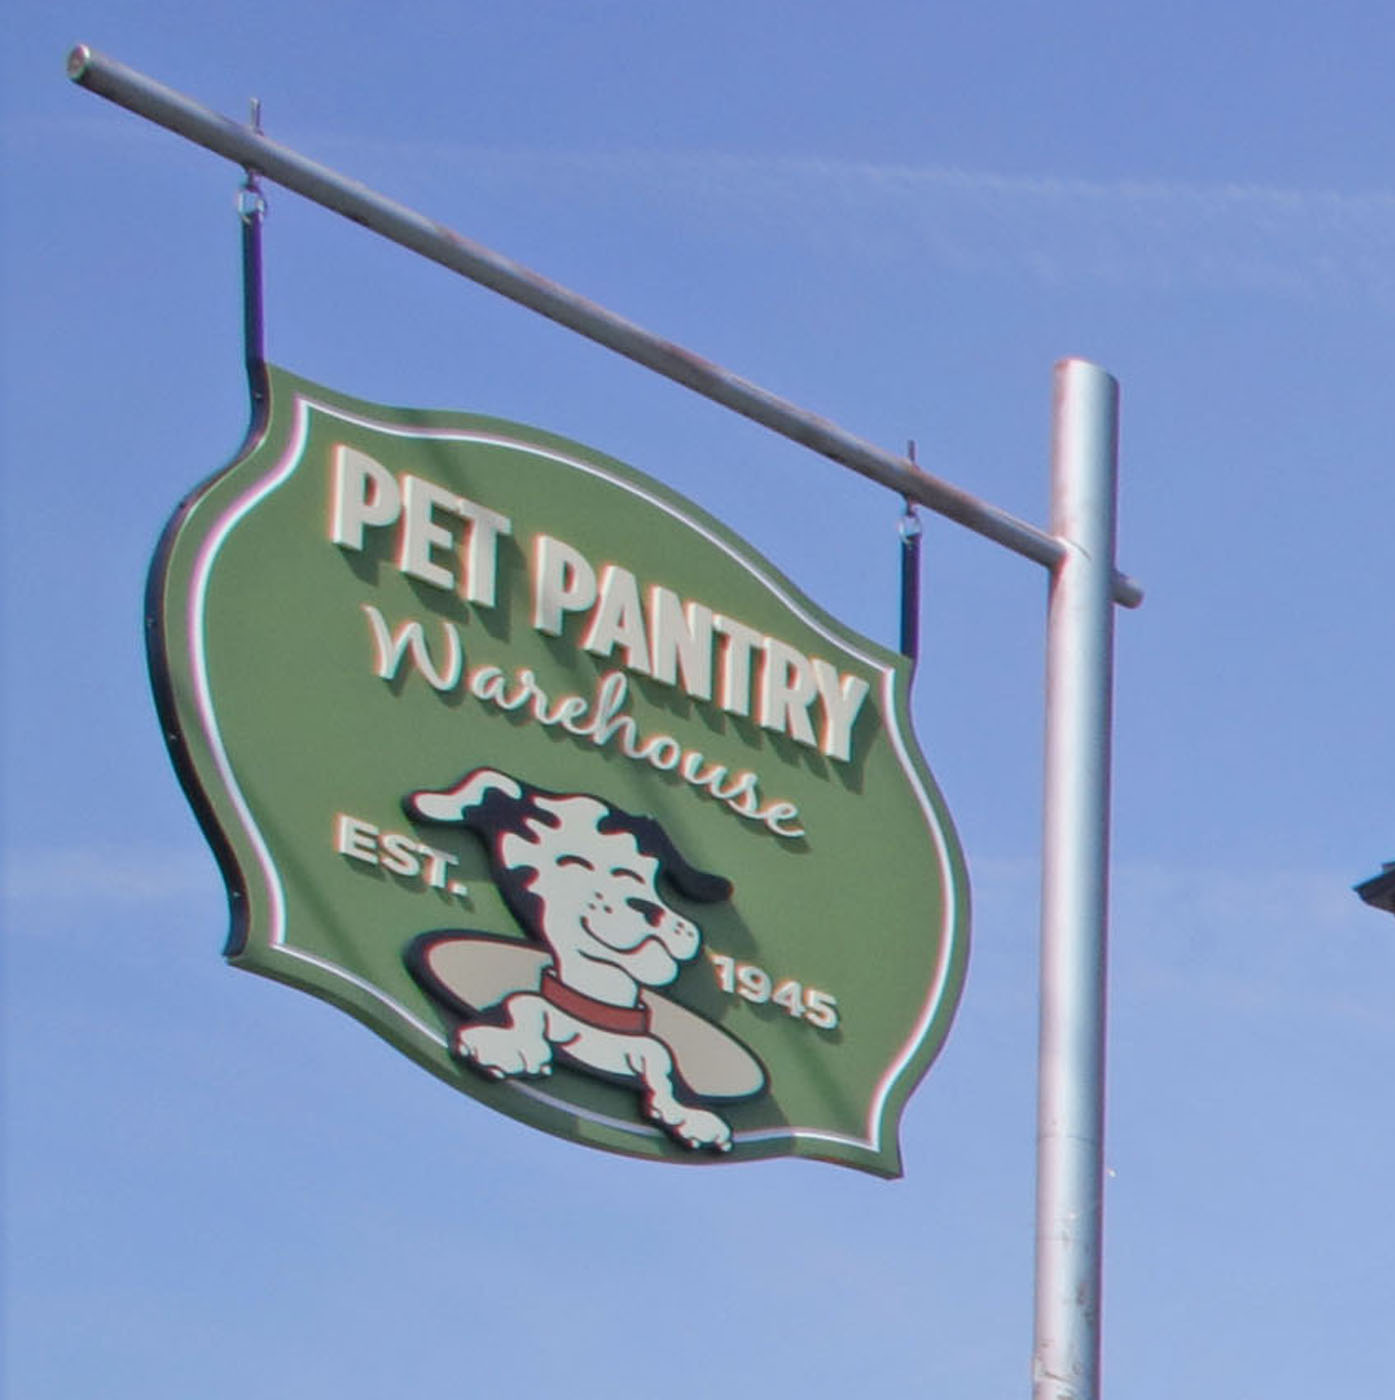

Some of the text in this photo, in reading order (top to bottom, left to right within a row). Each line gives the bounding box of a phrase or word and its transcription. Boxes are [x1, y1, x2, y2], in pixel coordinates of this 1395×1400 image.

[329, 444, 870, 764] PET PANTRY
[362, 605, 804, 838] Warehouse
[333, 812, 468, 897] EST.
[710, 953, 838, 1031] 1945
